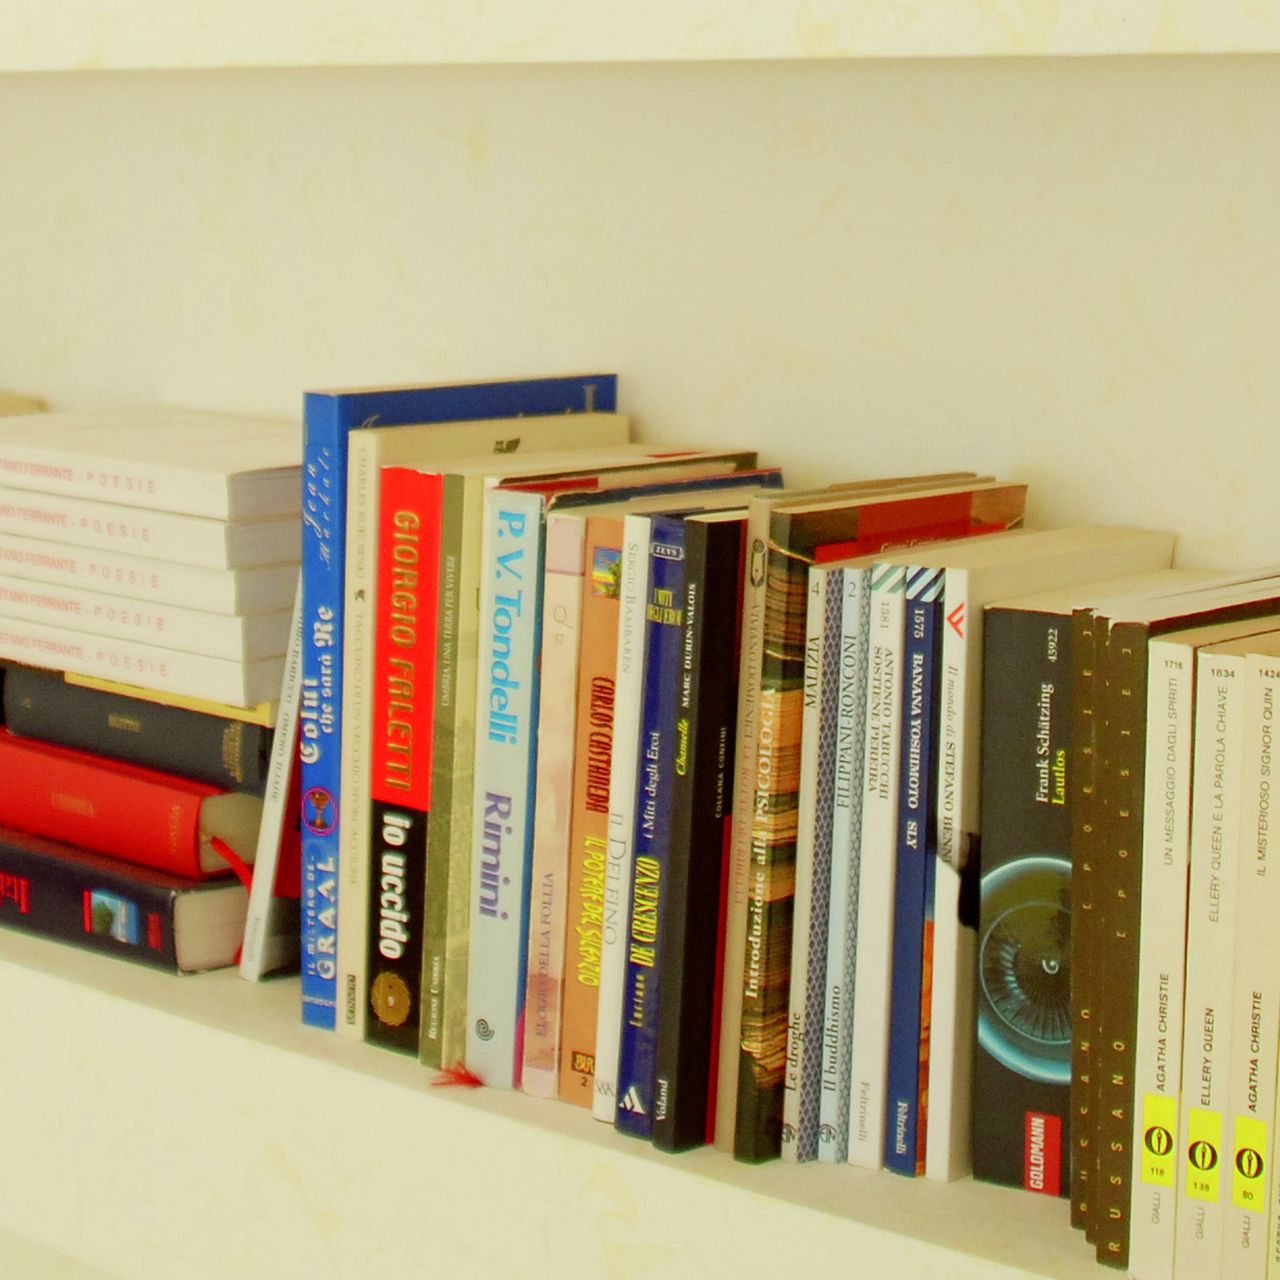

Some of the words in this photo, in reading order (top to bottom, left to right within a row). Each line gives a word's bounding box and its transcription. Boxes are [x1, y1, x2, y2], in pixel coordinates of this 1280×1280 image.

[497, 510, 527, 539] P.
[390, 510, 420, 648] GIORGIO
[495, 548, 524, 580] V.
[912, 608, 925, 639] 1575
[1047, 627, 1060, 663] 45922
[487, 589, 523, 745] Tondelli
[804, 635, 820, 710] MALIZIA
[871, 645, 884, 723] SOSTIENE
[881, 647, 895, 722] ANTONIO
[910, 653, 925, 721] BANANA
[1167, 676, 1179, 720] SPIRITI
[299, 677, 320, 764] Colui
[321, 703, 336, 734] che
[384, 656, 415, 792] FALETTI
[590, 676, 616, 725] CARLOS
[836, 634, 858, 809] FILIPPANI-RONCONI
[945, 679, 958, 723] mondo
[945, 724, 957, 738] di
[1036, 682, 1055, 760] Schätzing
[585, 728, 613, 814] CASTANEDA
[752, 687, 777, 823] PSICOLOGIA
[867, 724, 882, 794] PEREIRA
[879, 724, 893, 800] TABUCCHI
[907, 722, 923, 810] YOSHIMOTO
[1167, 722, 1177, 763] DAGLI
[942, 741, 957, 811] STEFANO
[1036, 765, 1052, 804] Frank
[1051, 748, 1067, 806] Lautlos
[1164, 765, 1177, 845] MESSAGGIO
[383, 812, 413, 847] io
[478, 791, 513, 920] Rimini
[749, 830, 767, 866] alla
[905, 820, 919, 850] SLY
[940, 815, 954, 864] BENNI
[1163, 846, 1175, 867] UN
[316, 855, 338, 982] GRAAL
[379, 853, 412, 960] uccido
[631, 856, 661, 944] CRESCENZO
[630, 944, 656, 969] DE
[743, 872, 767, 1000] Introduzione
[824, 984, 842, 1075] buddhismo
[1158, 972, 1170, 1032] CHRISTIE
[1203, 1007, 1215, 1054] QUEEN
[787, 1012, 806, 1068] droghe
[1156, 1038, 1168, 1093] AGATHA
[784, 1072, 797, 1094] Le
[1200, 1056, 1212, 1107] ELLERY
[1029, 1115, 1046, 1190] GOLDMANN
